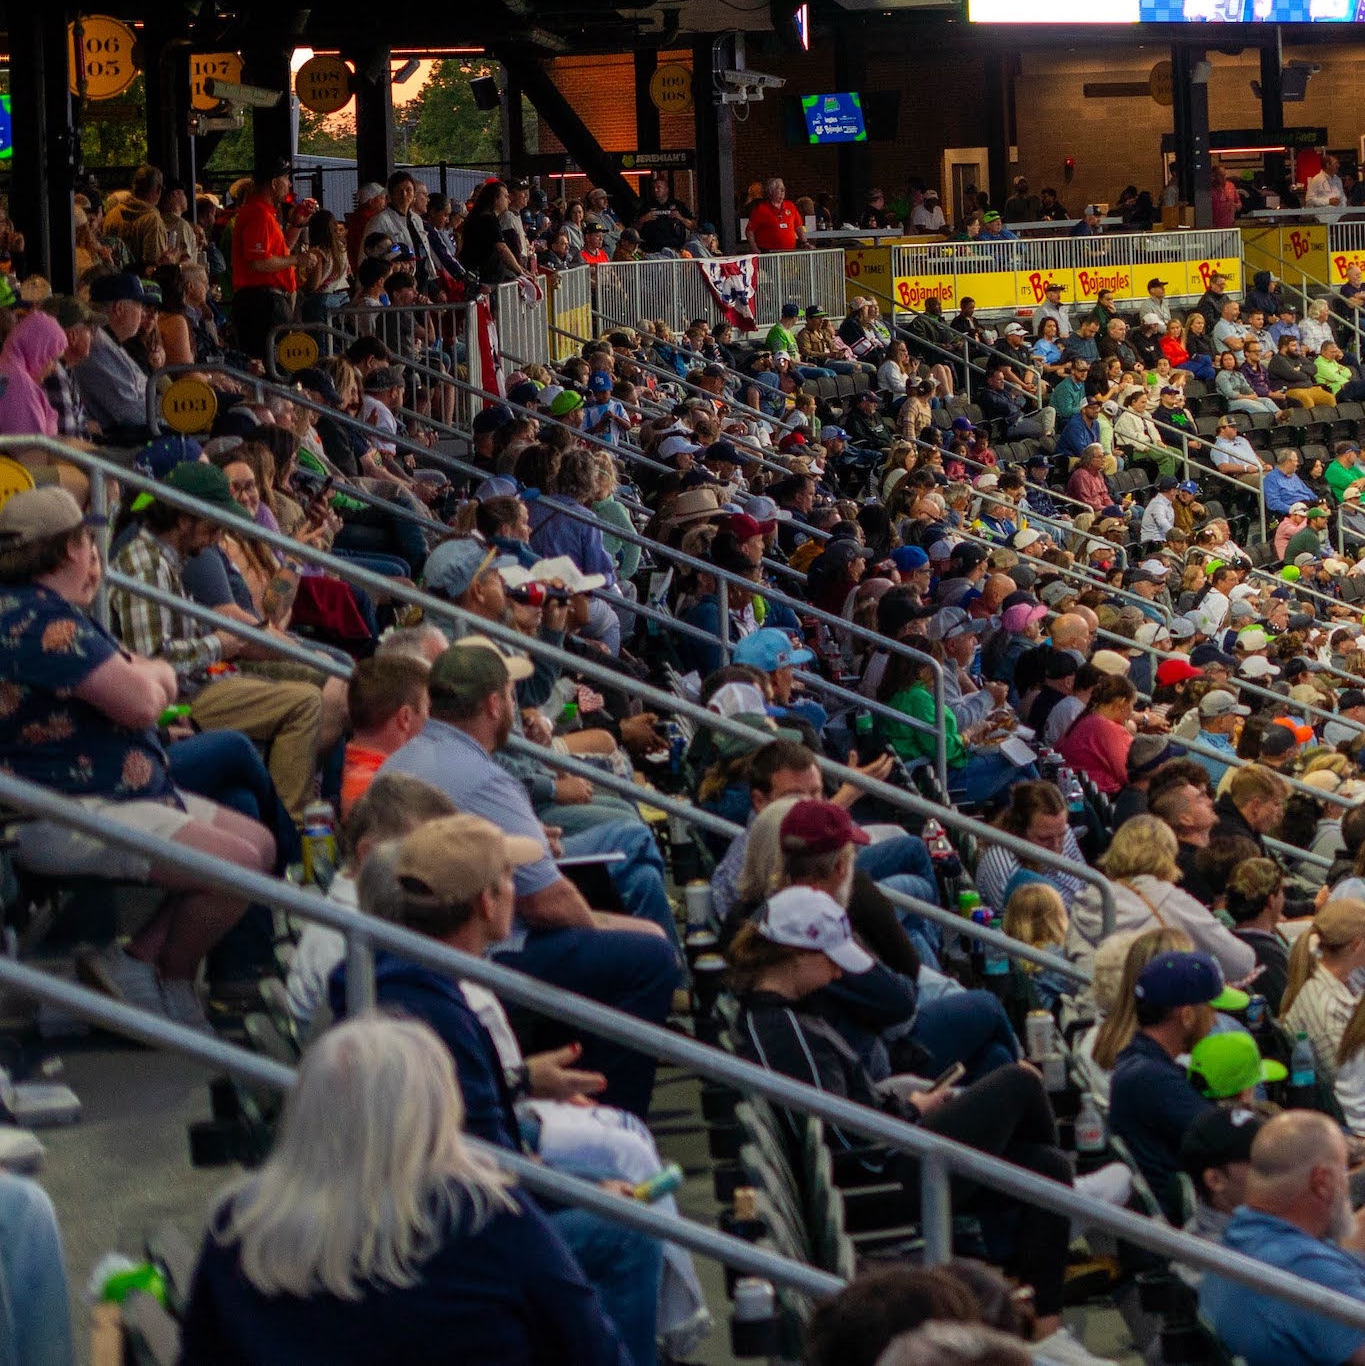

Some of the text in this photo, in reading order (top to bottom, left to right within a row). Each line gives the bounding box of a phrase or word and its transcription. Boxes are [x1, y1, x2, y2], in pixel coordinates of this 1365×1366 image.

[86, 37, 120, 53] 06
[87, 60, 120, 76] 05
[192, 62, 230, 75] 107
[310, 72, 340, 82] 108
[662, 77, 684, 86] 109
[662, 92, 685, 101] 108
[636, 153, 687, 163] JEREMIAH'S
[1293, 229, 1310, 259] Bo
[864, 265, 885, 274] TIME!
[898, 281, 953, 308] Bojangles
[1021, 285, 1031, 295] IT'S
[1078, 269, 1130, 297] Bojangles
[1191, 275, 1200, 284] IT'S
[172, 399, 208, 413] 103
